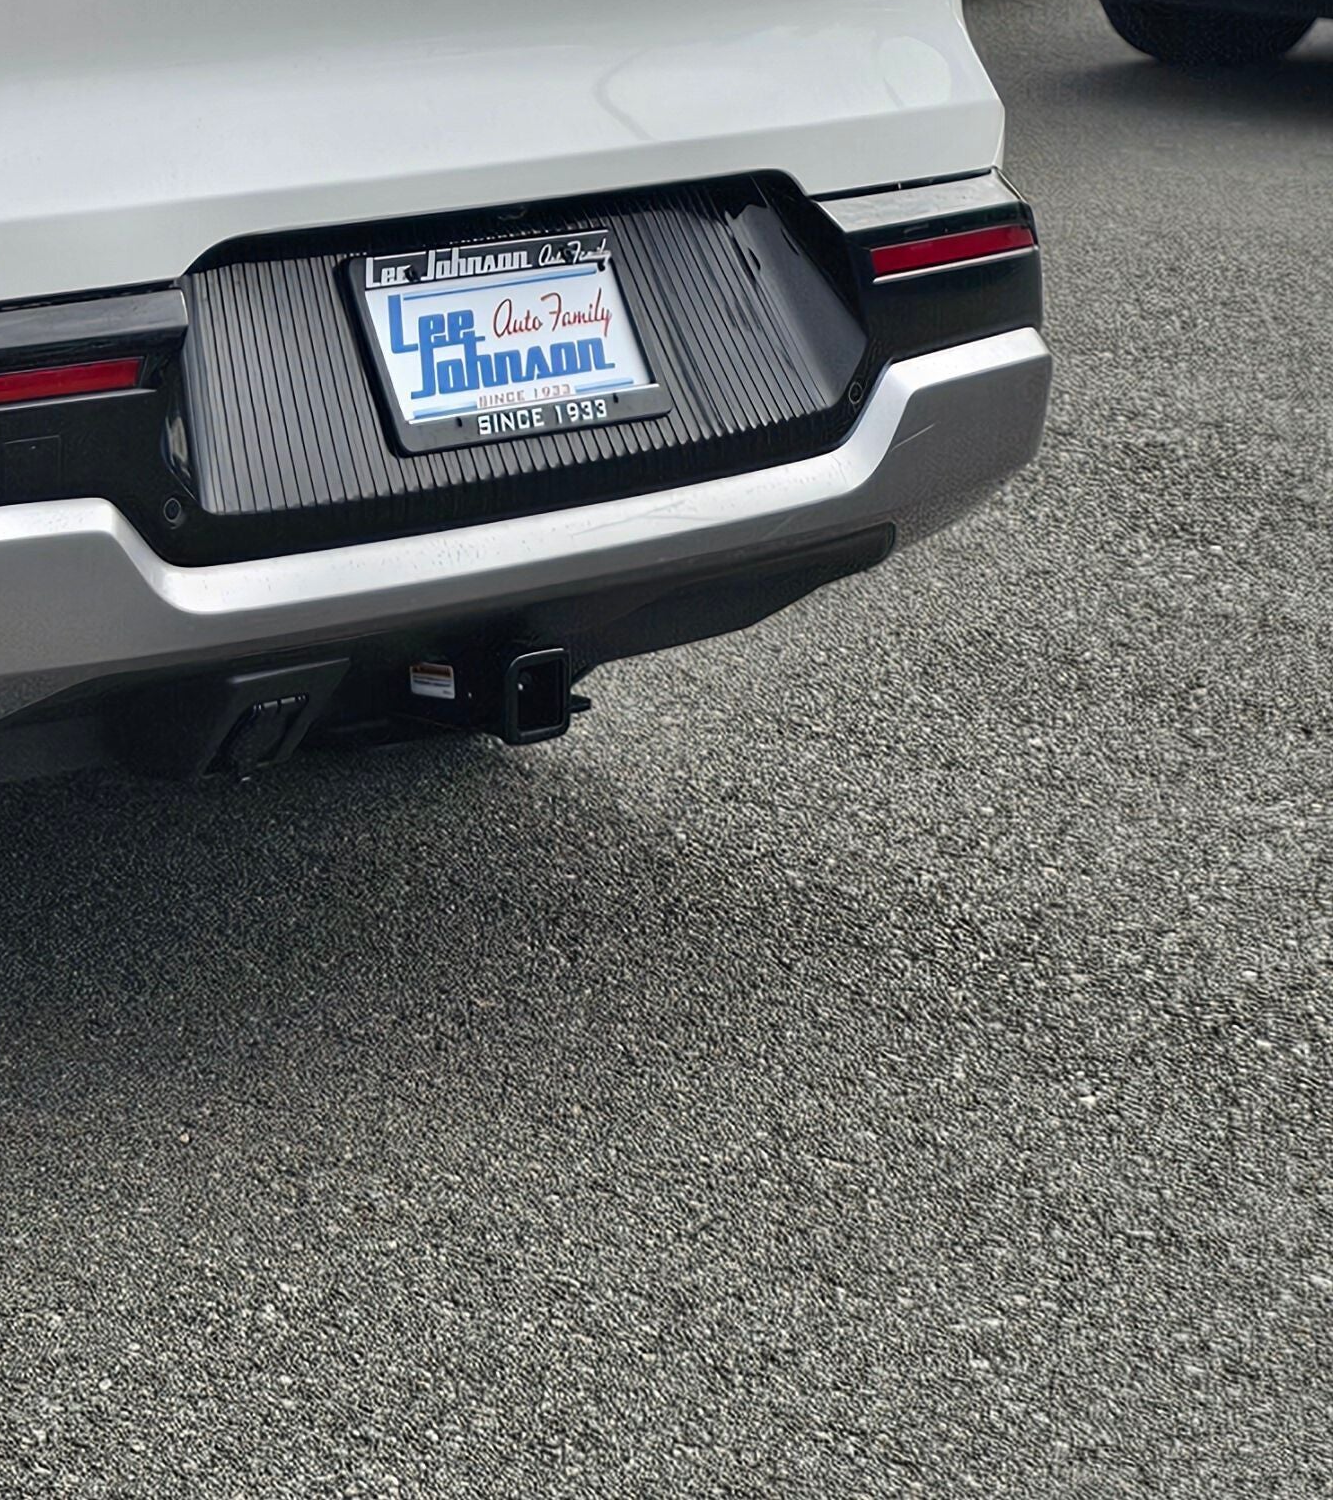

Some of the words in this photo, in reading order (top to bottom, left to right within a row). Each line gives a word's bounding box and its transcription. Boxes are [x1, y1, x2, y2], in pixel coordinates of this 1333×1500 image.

[420, 247, 533, 280] Johnson
[388, 294, 479, 353] Lee
[493, 299, 543, 338] Auto
[541, 287, 613, 337] Family
[411, 334, 616, 399] Johnson
[477, 408, 545, 435] SINCE
[555, 399, 608, 425] 1933
[479, 390, 526, 408] SINCE
[534, 384, 571, 398] 1933
